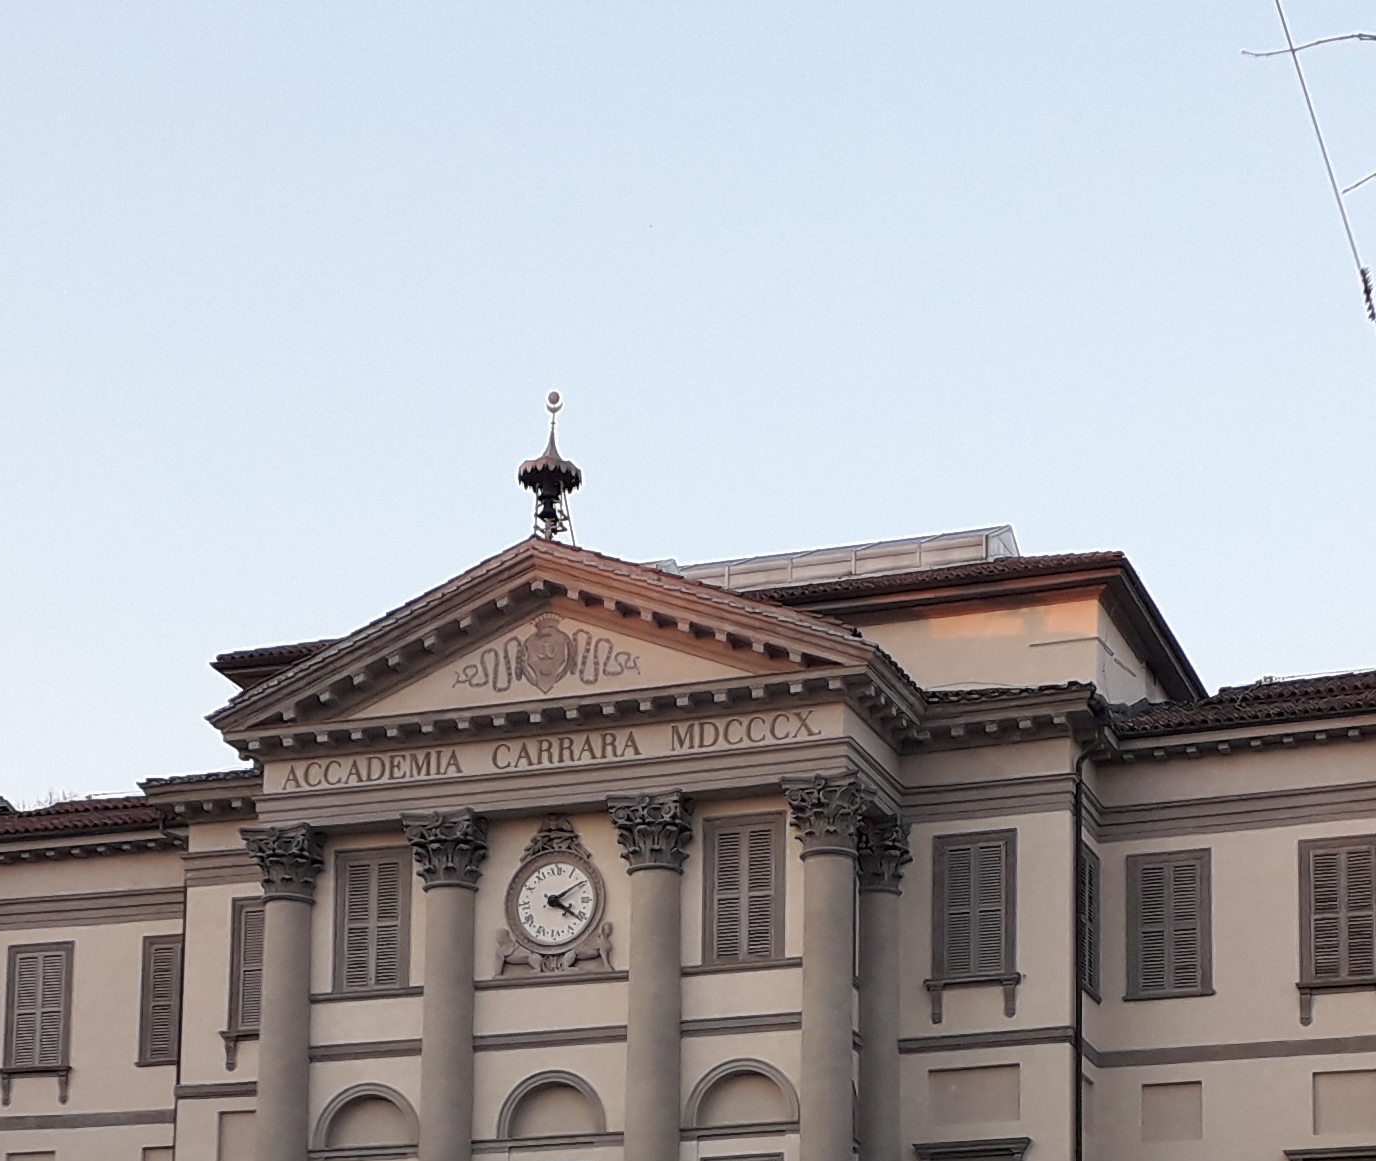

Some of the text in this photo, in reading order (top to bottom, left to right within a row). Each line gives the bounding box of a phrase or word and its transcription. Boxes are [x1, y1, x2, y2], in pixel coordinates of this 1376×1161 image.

[281, 710, 822, 790] ACCADEMIA CARRARA MDCCCX
